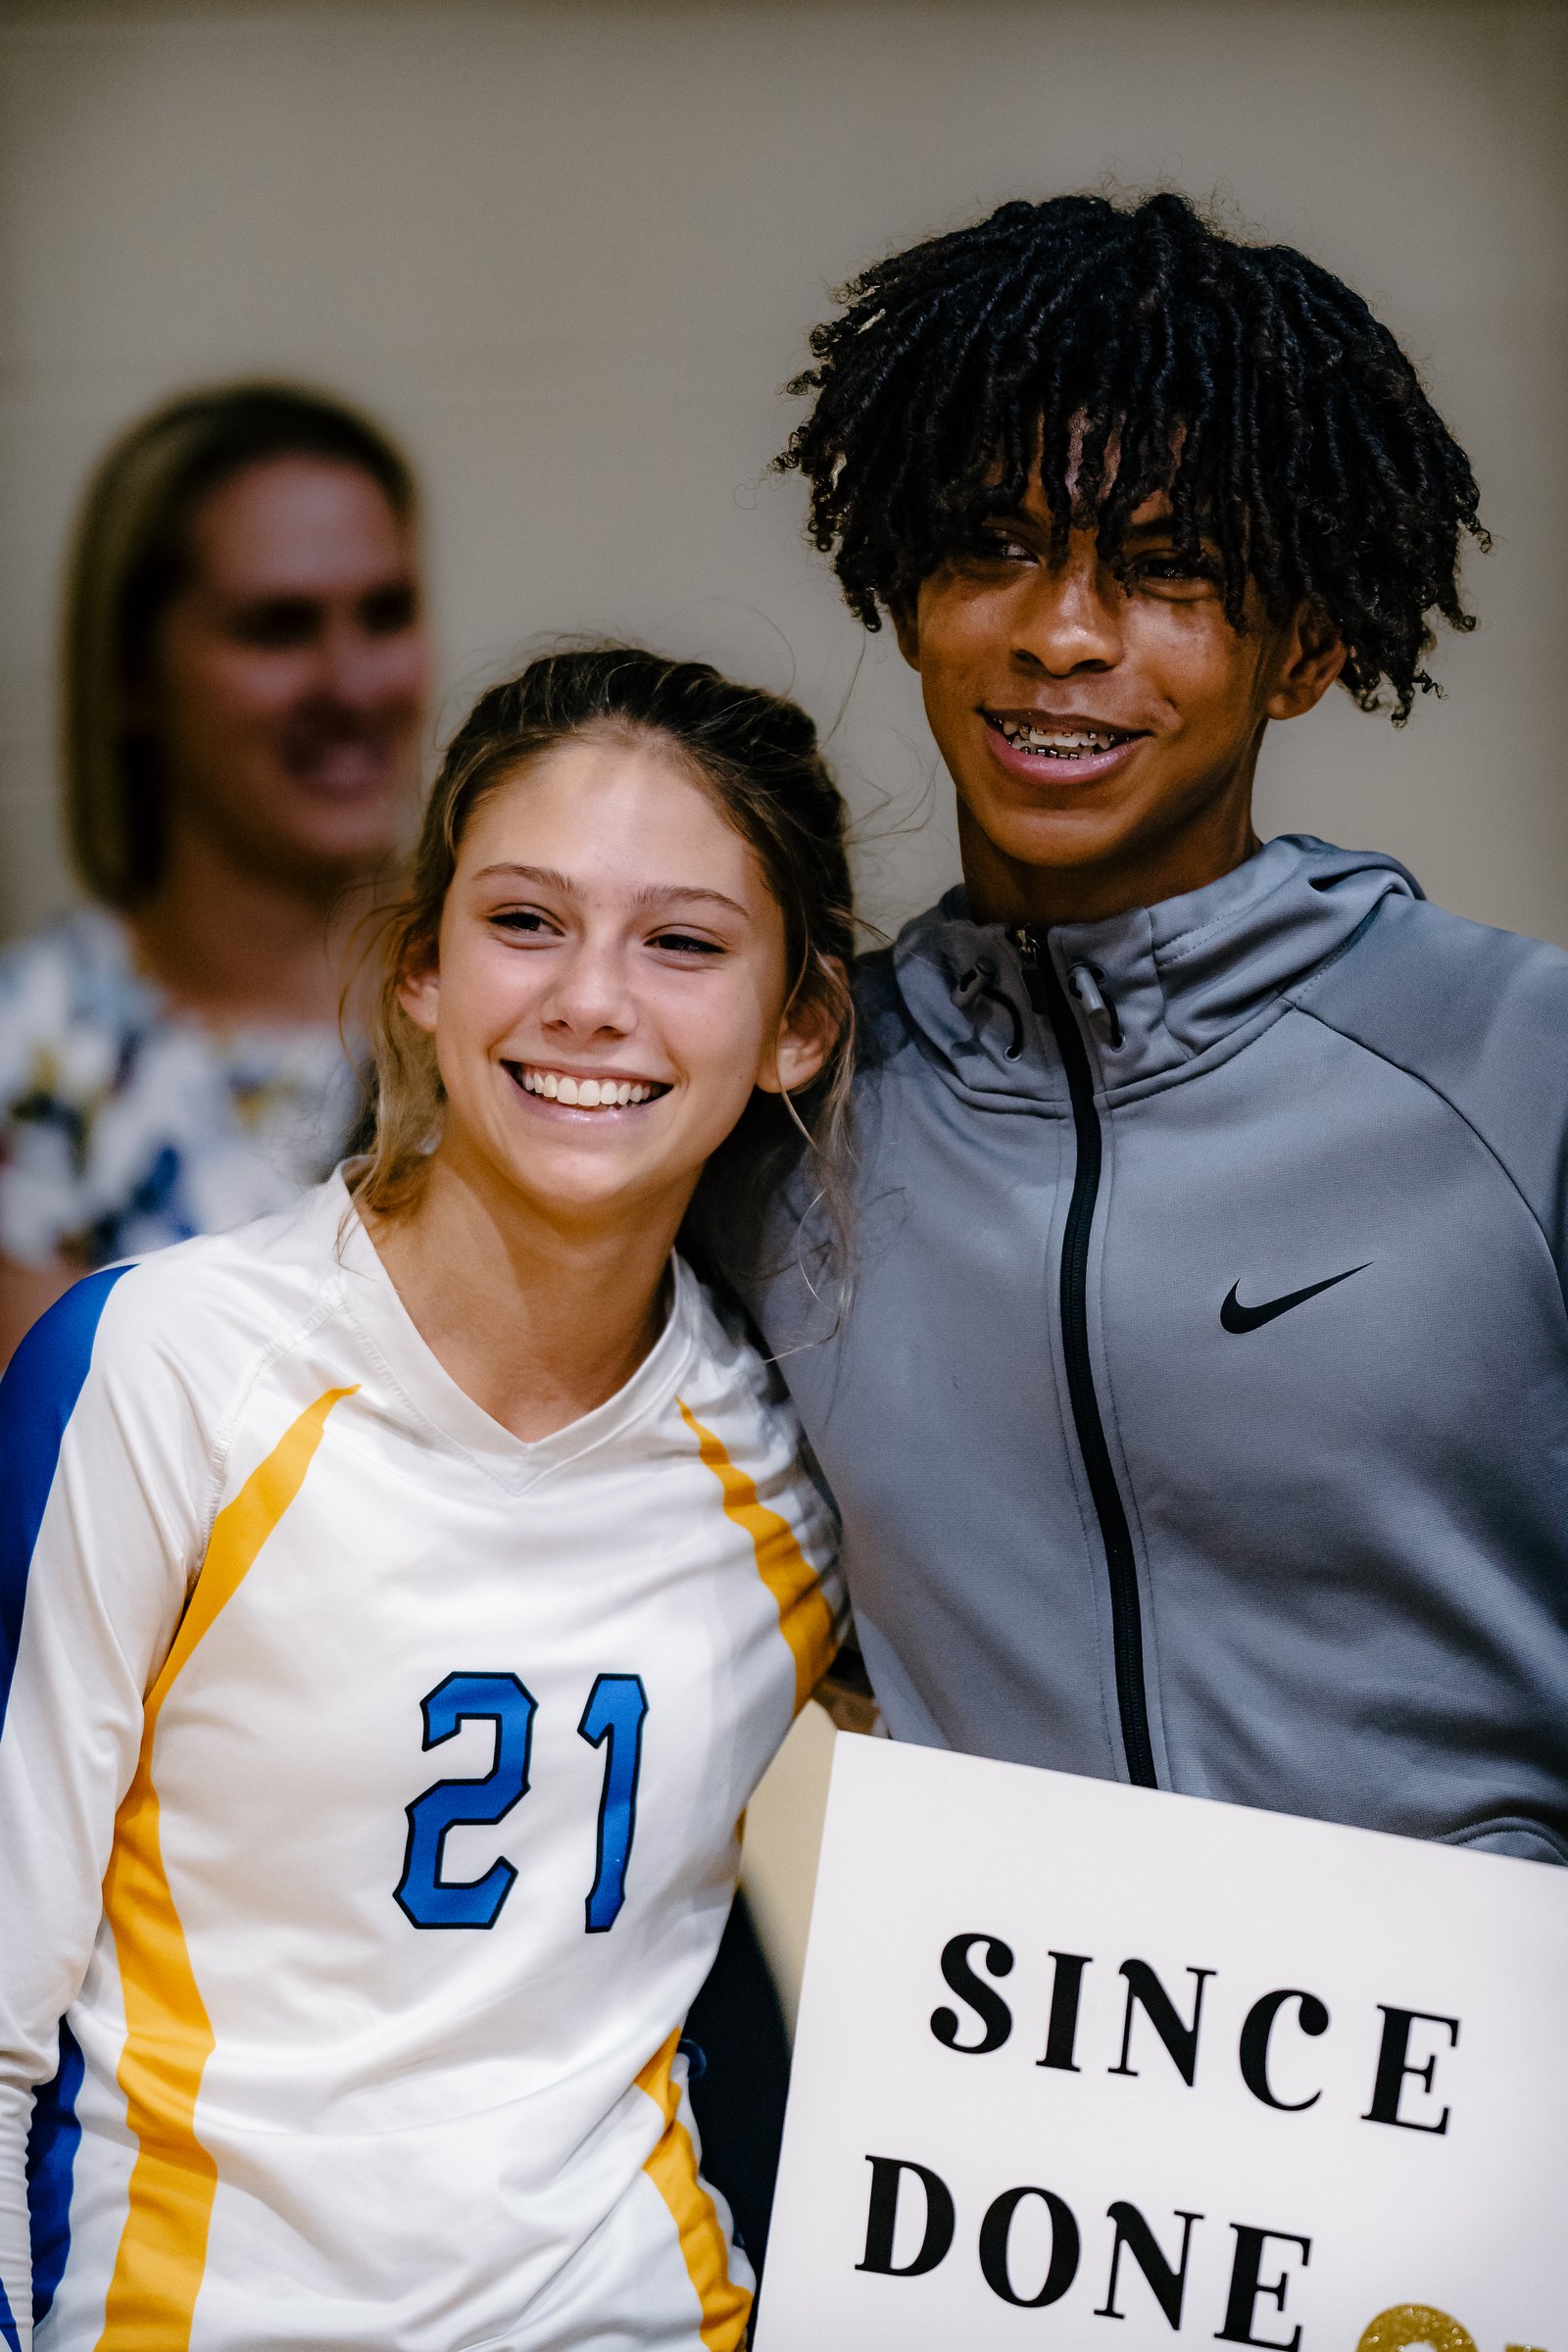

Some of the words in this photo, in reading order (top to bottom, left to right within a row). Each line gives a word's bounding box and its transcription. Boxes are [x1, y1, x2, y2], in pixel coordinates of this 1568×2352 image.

[392, 1671, 650, 1935] 21
[930, 1933, 1460, 2135] SINCE
[855, 2154, 1312, 2352] DONE
